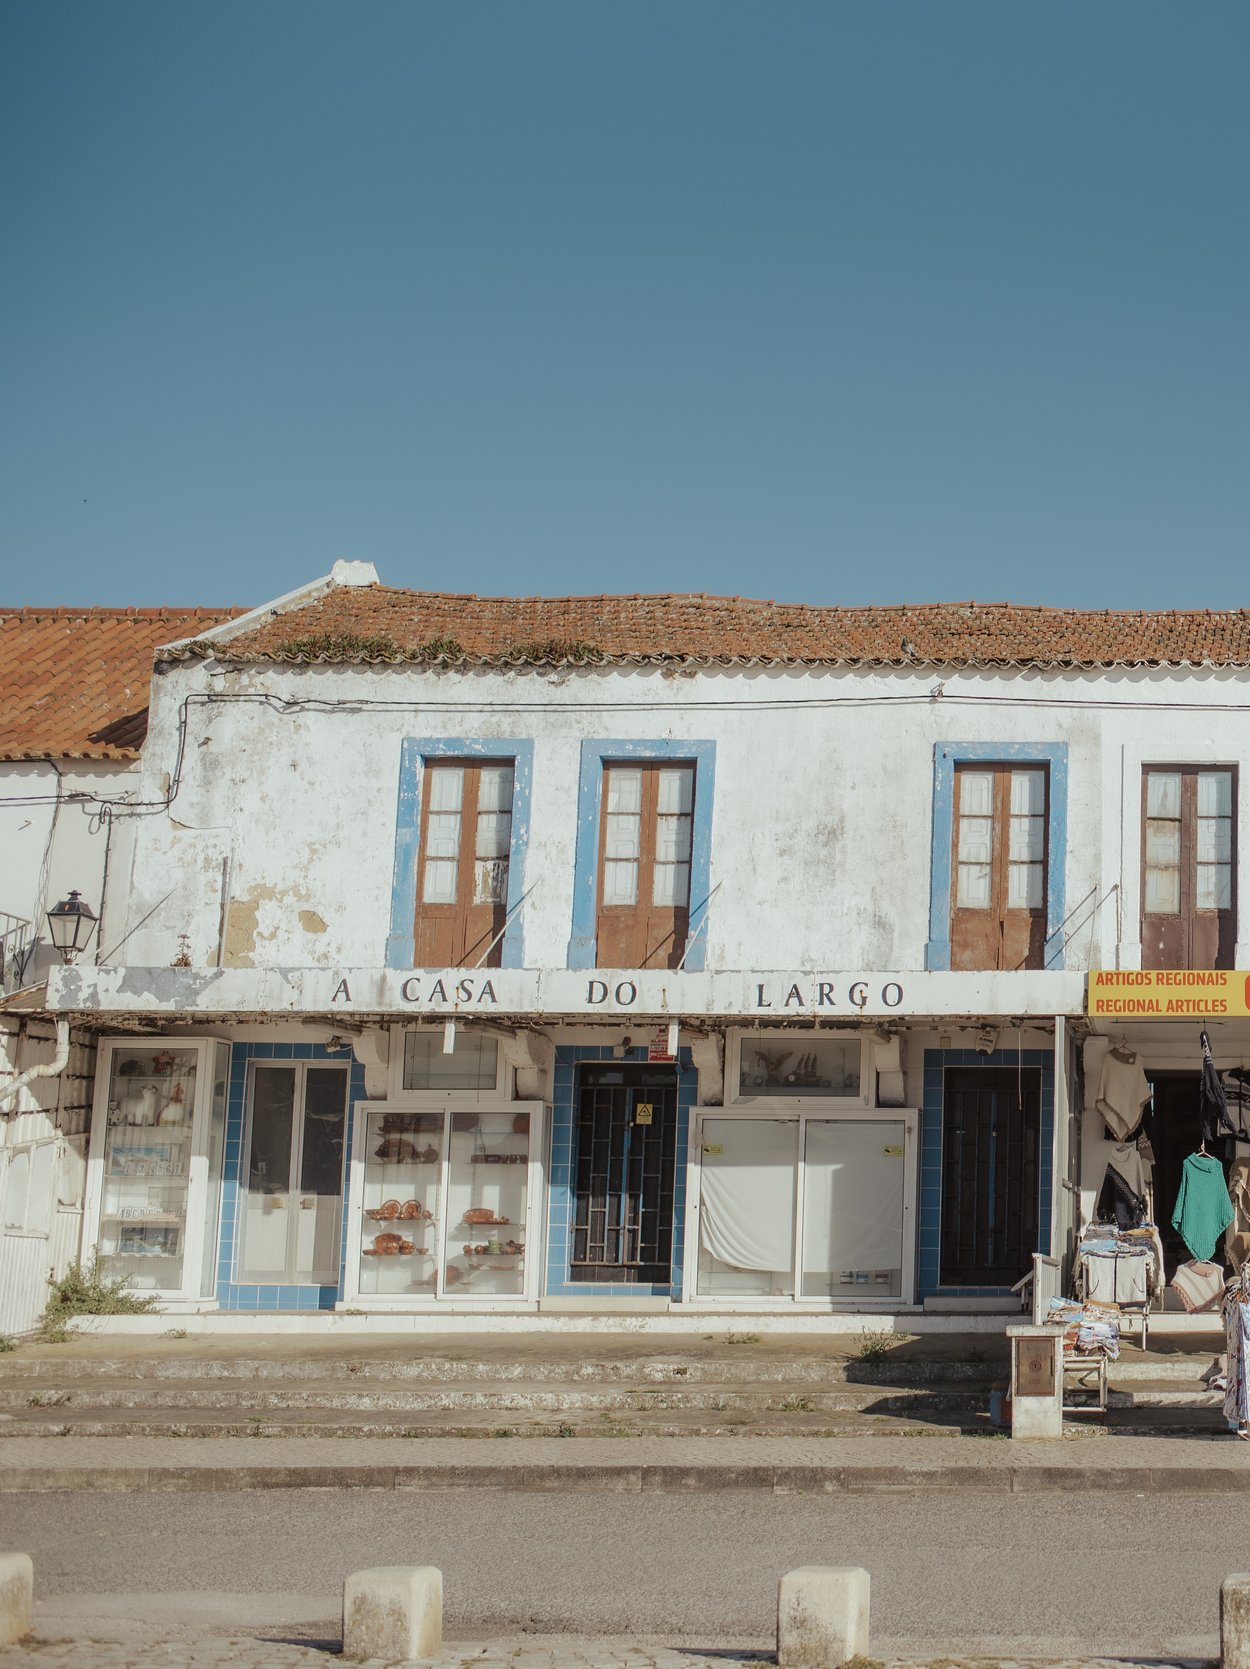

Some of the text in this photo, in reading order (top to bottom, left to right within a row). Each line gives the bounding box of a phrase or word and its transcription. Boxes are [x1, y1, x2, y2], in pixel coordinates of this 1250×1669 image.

[1095, 972, 1228, 986] ARTIGOS REGIONAIS
[331, 977, 904, 1008] A CASA DO LARGO
[1095, 999, 1228, 1013] REGIONAL ARTICLES
